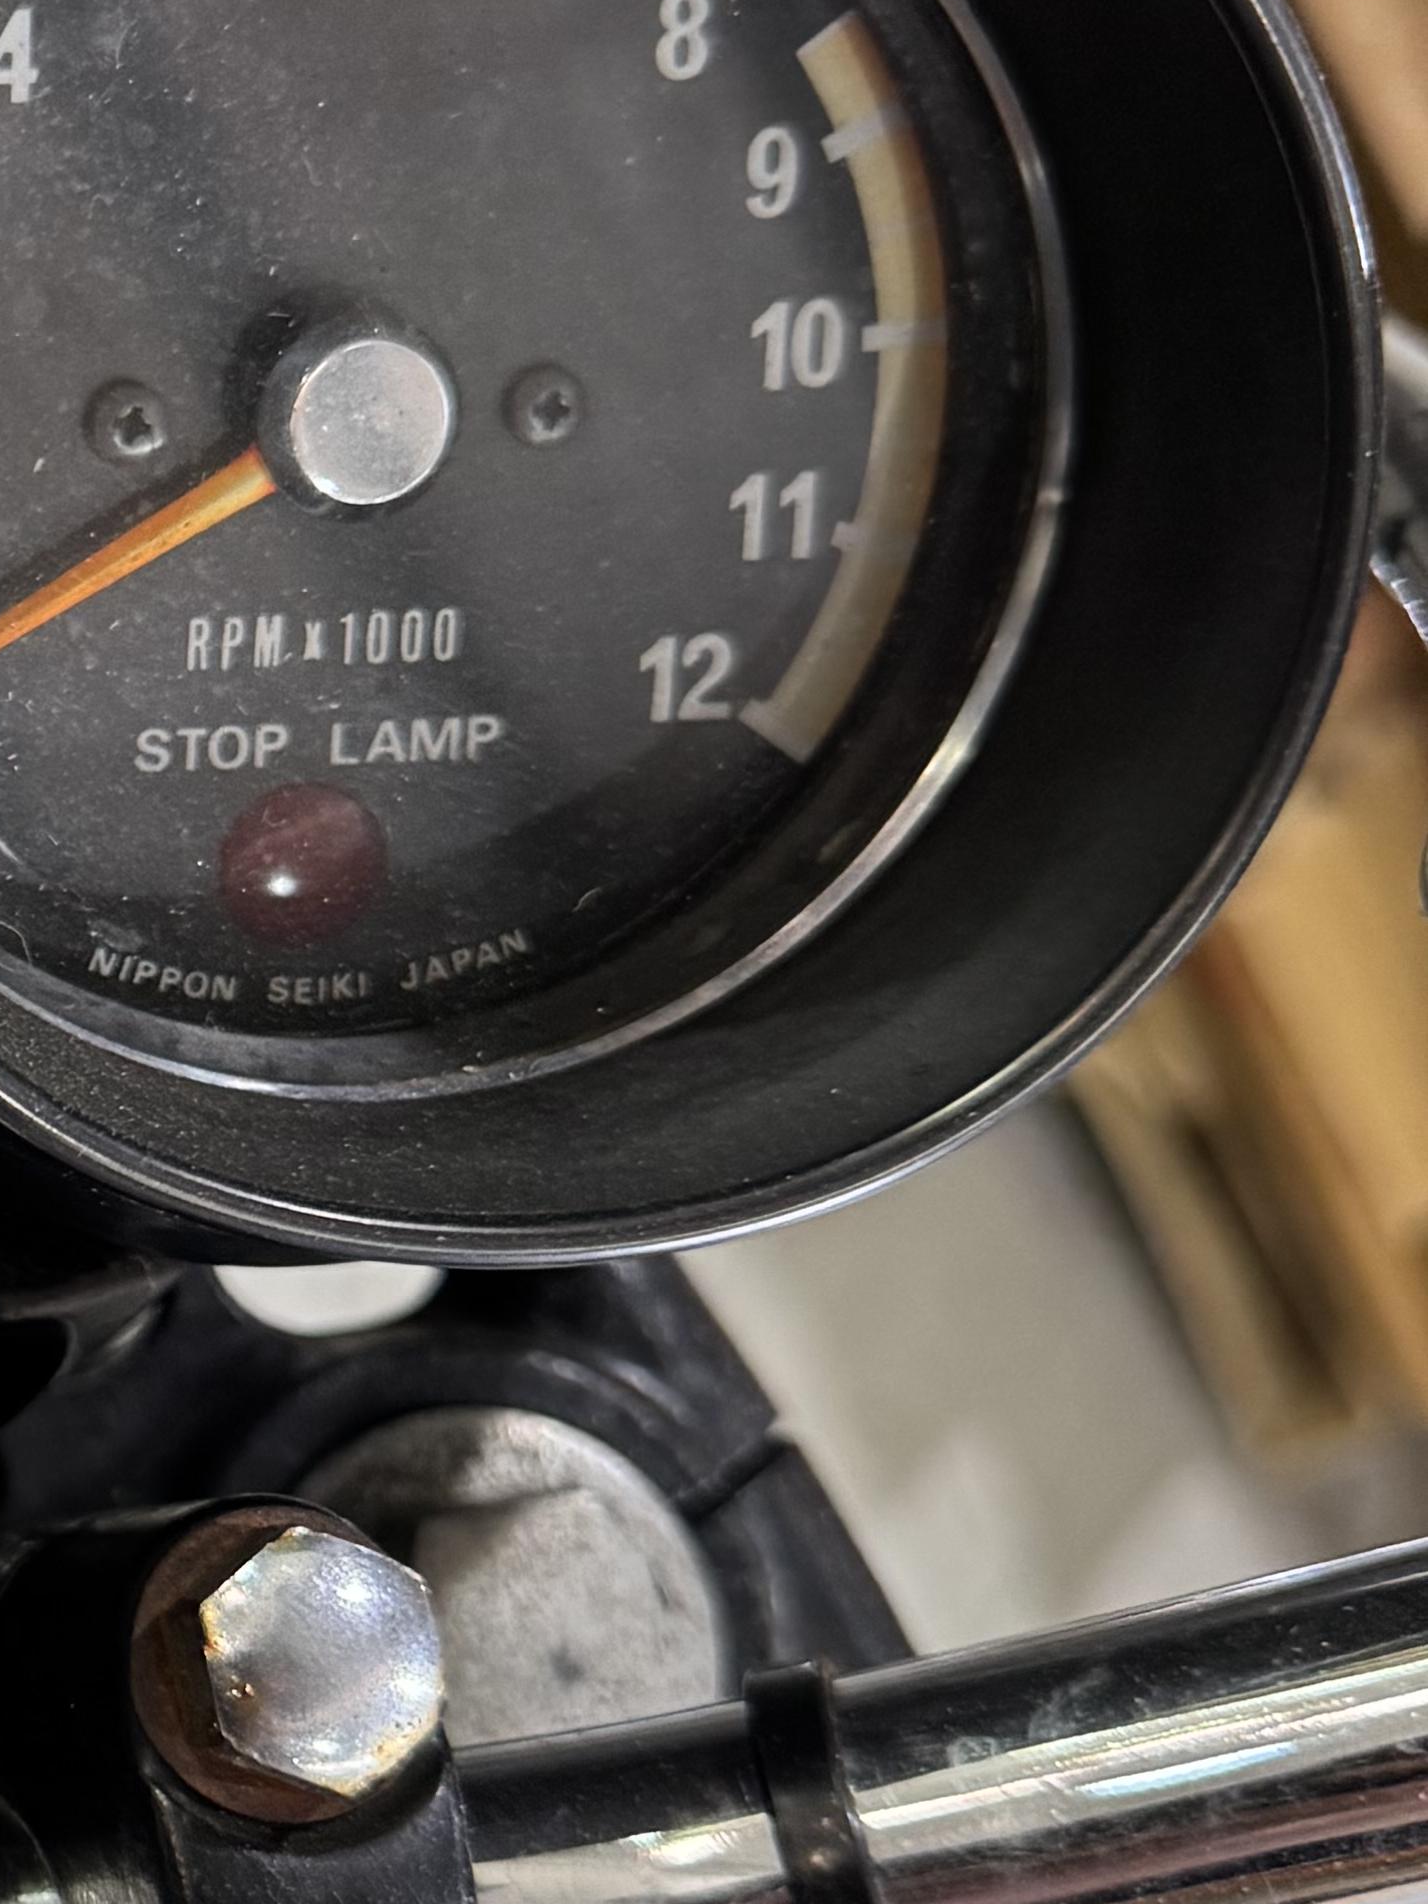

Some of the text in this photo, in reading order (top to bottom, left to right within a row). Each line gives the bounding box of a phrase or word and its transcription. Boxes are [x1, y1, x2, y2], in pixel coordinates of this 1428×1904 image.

[746, 127, 799, 219] 9
[751, 299, 844, 390] 10
[729, 473, 818, 560] 11
[187, 613, 284, 671] RPM
[640, 633, 730, 722] 12
[134, 714, 502, 773] STOP LAMP
[88, 927, 530, 1006] NIPPON SEIKI JAPAN
